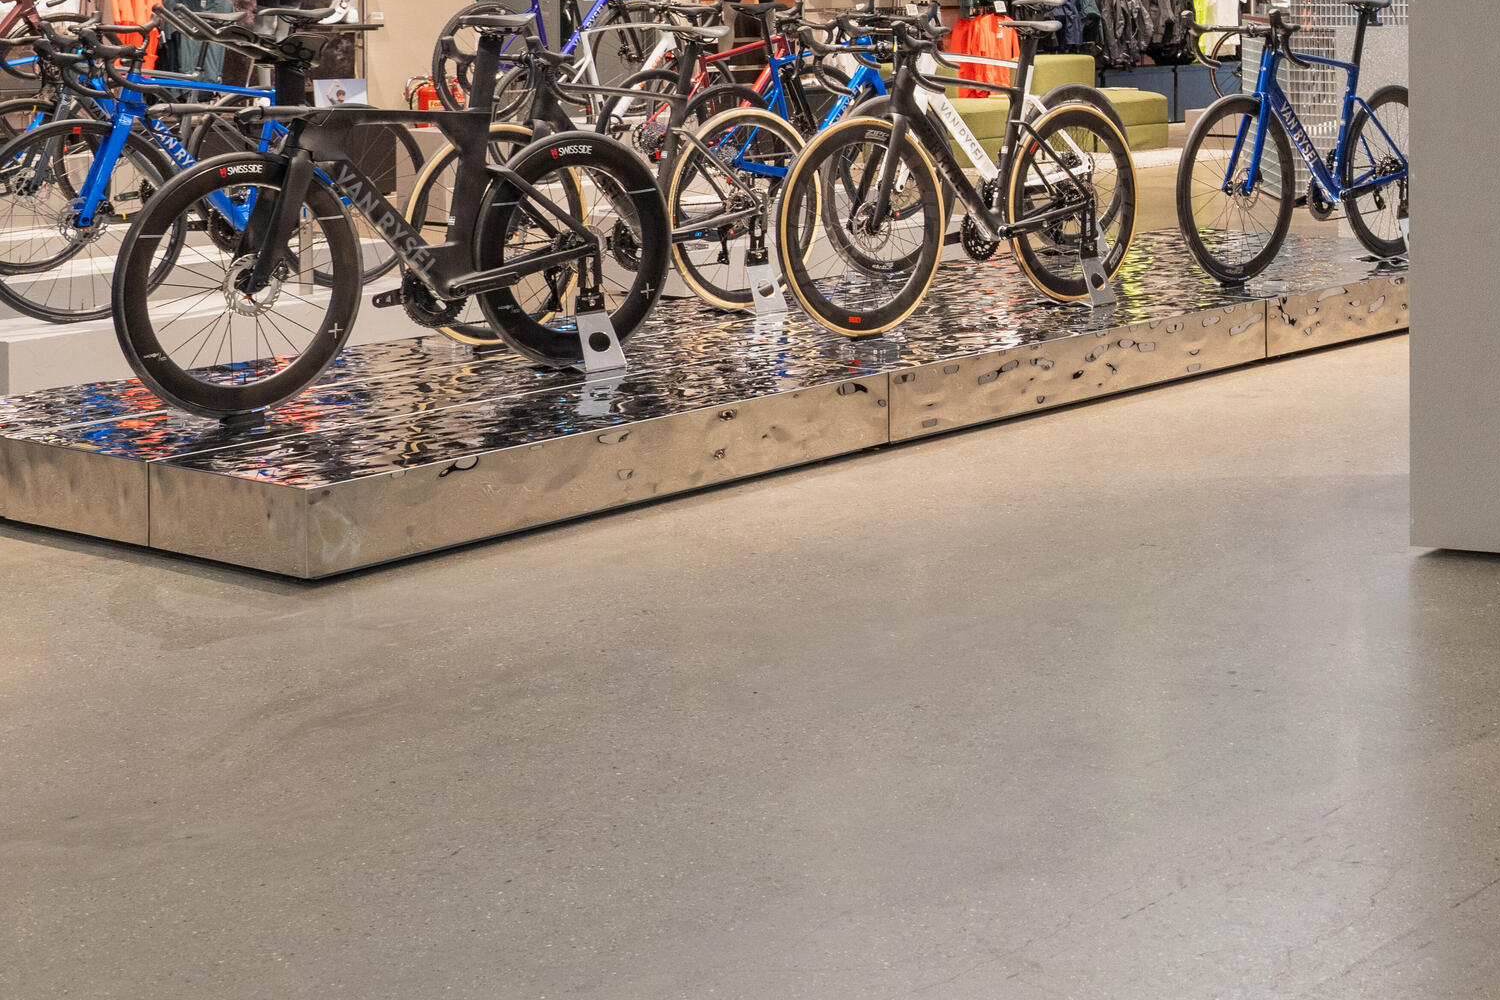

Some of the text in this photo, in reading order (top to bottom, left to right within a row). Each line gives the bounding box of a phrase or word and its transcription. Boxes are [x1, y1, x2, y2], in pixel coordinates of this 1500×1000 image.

[1280, 100, 1319, 168] VAN RYSEL
[337, 164, 437, 279] VAN RYSEL
